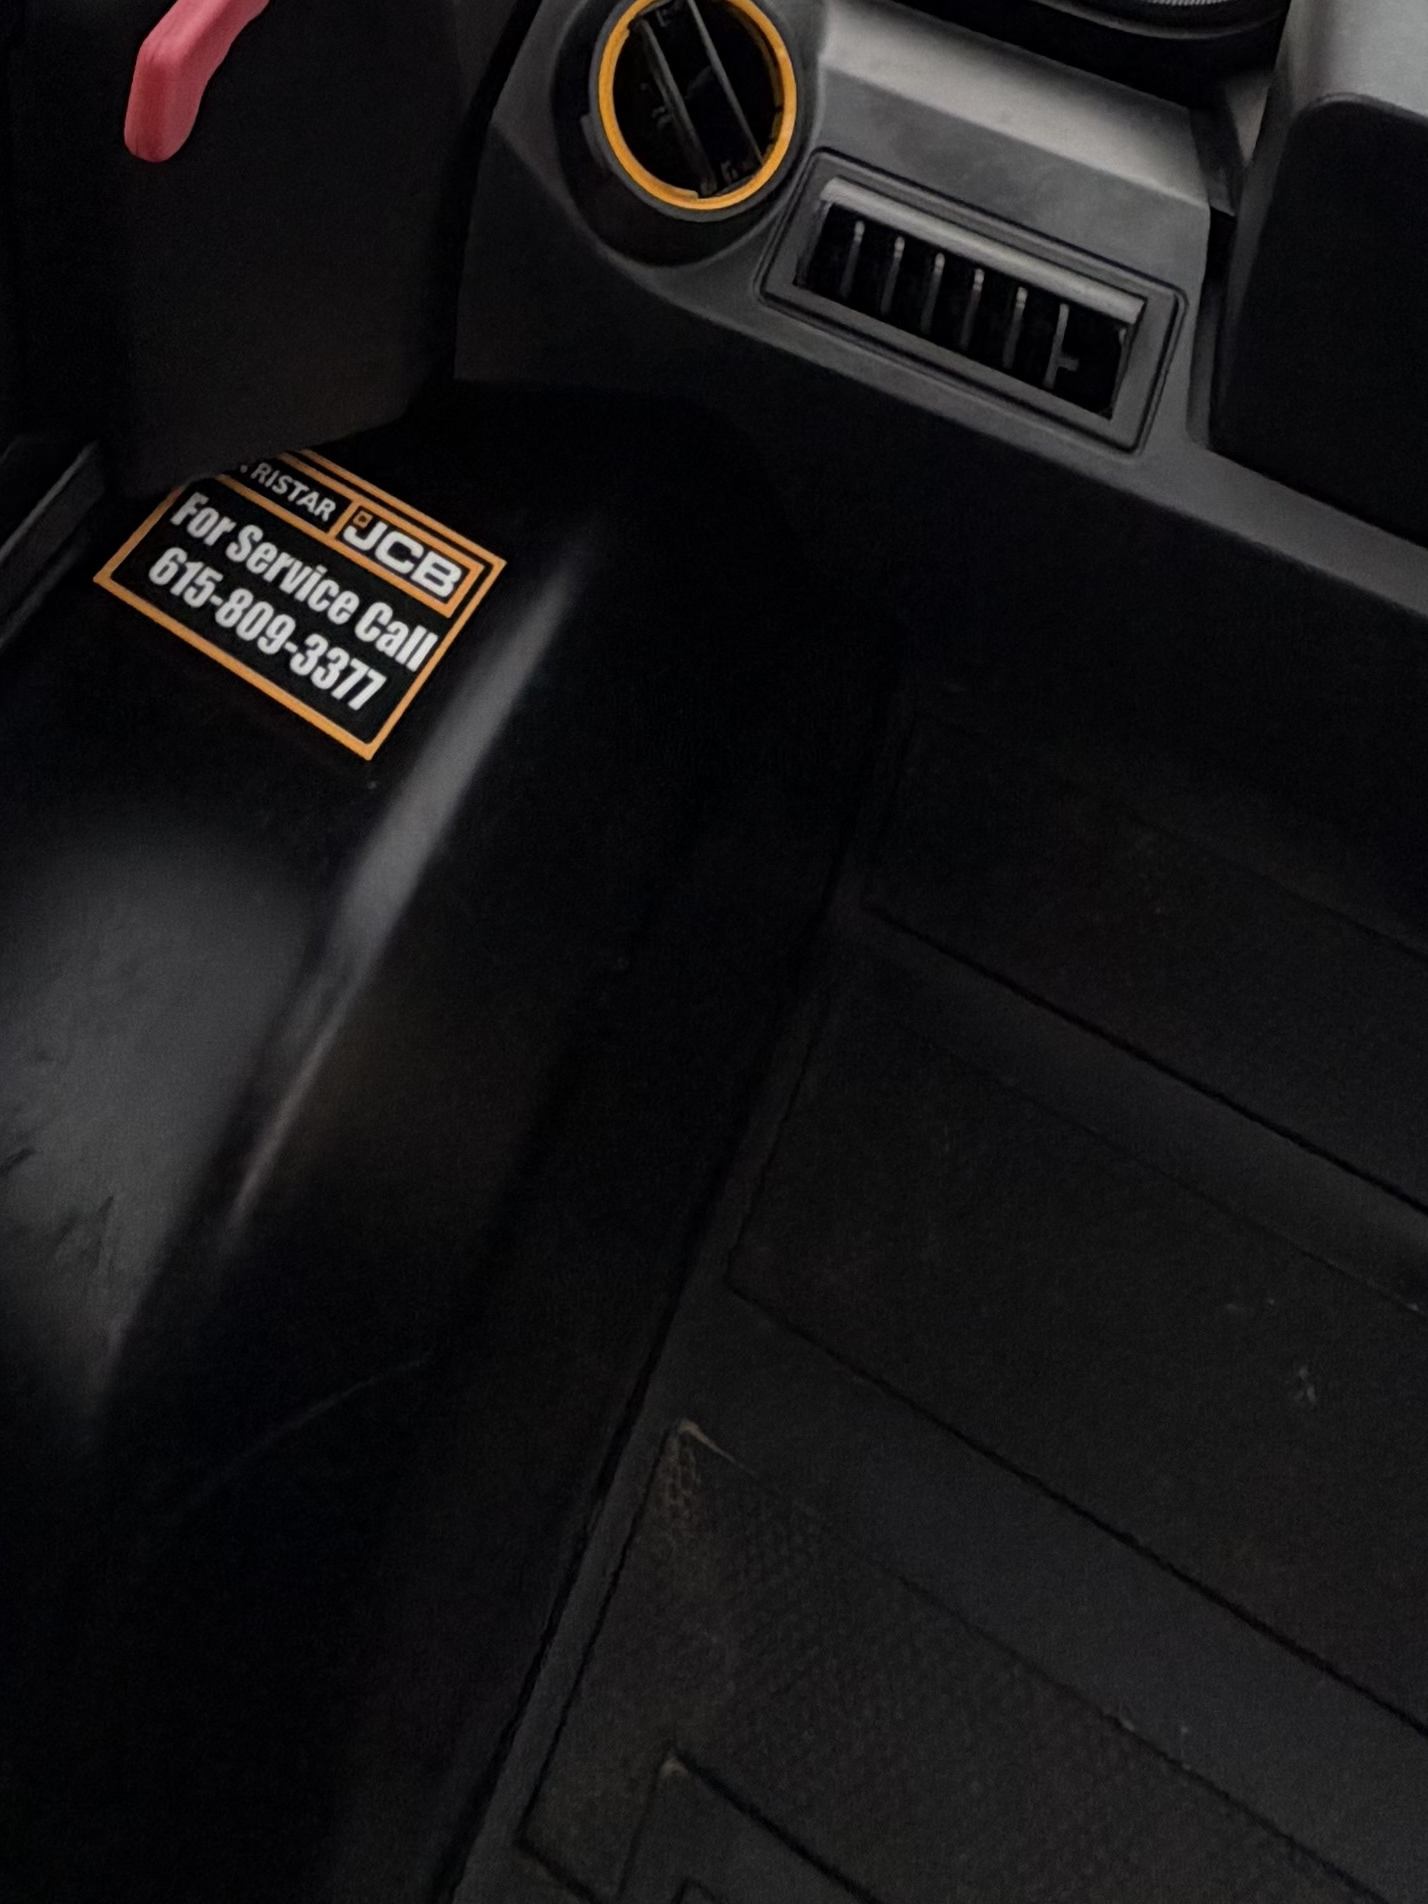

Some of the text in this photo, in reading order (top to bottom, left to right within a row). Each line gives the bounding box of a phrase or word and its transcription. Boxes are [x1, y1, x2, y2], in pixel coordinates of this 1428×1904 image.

[170, 492, 439, 673] For Service Call
[239, 462, 462, 599] RISTAR JCB
[148, 546, 388, 712] 615-809-3377
